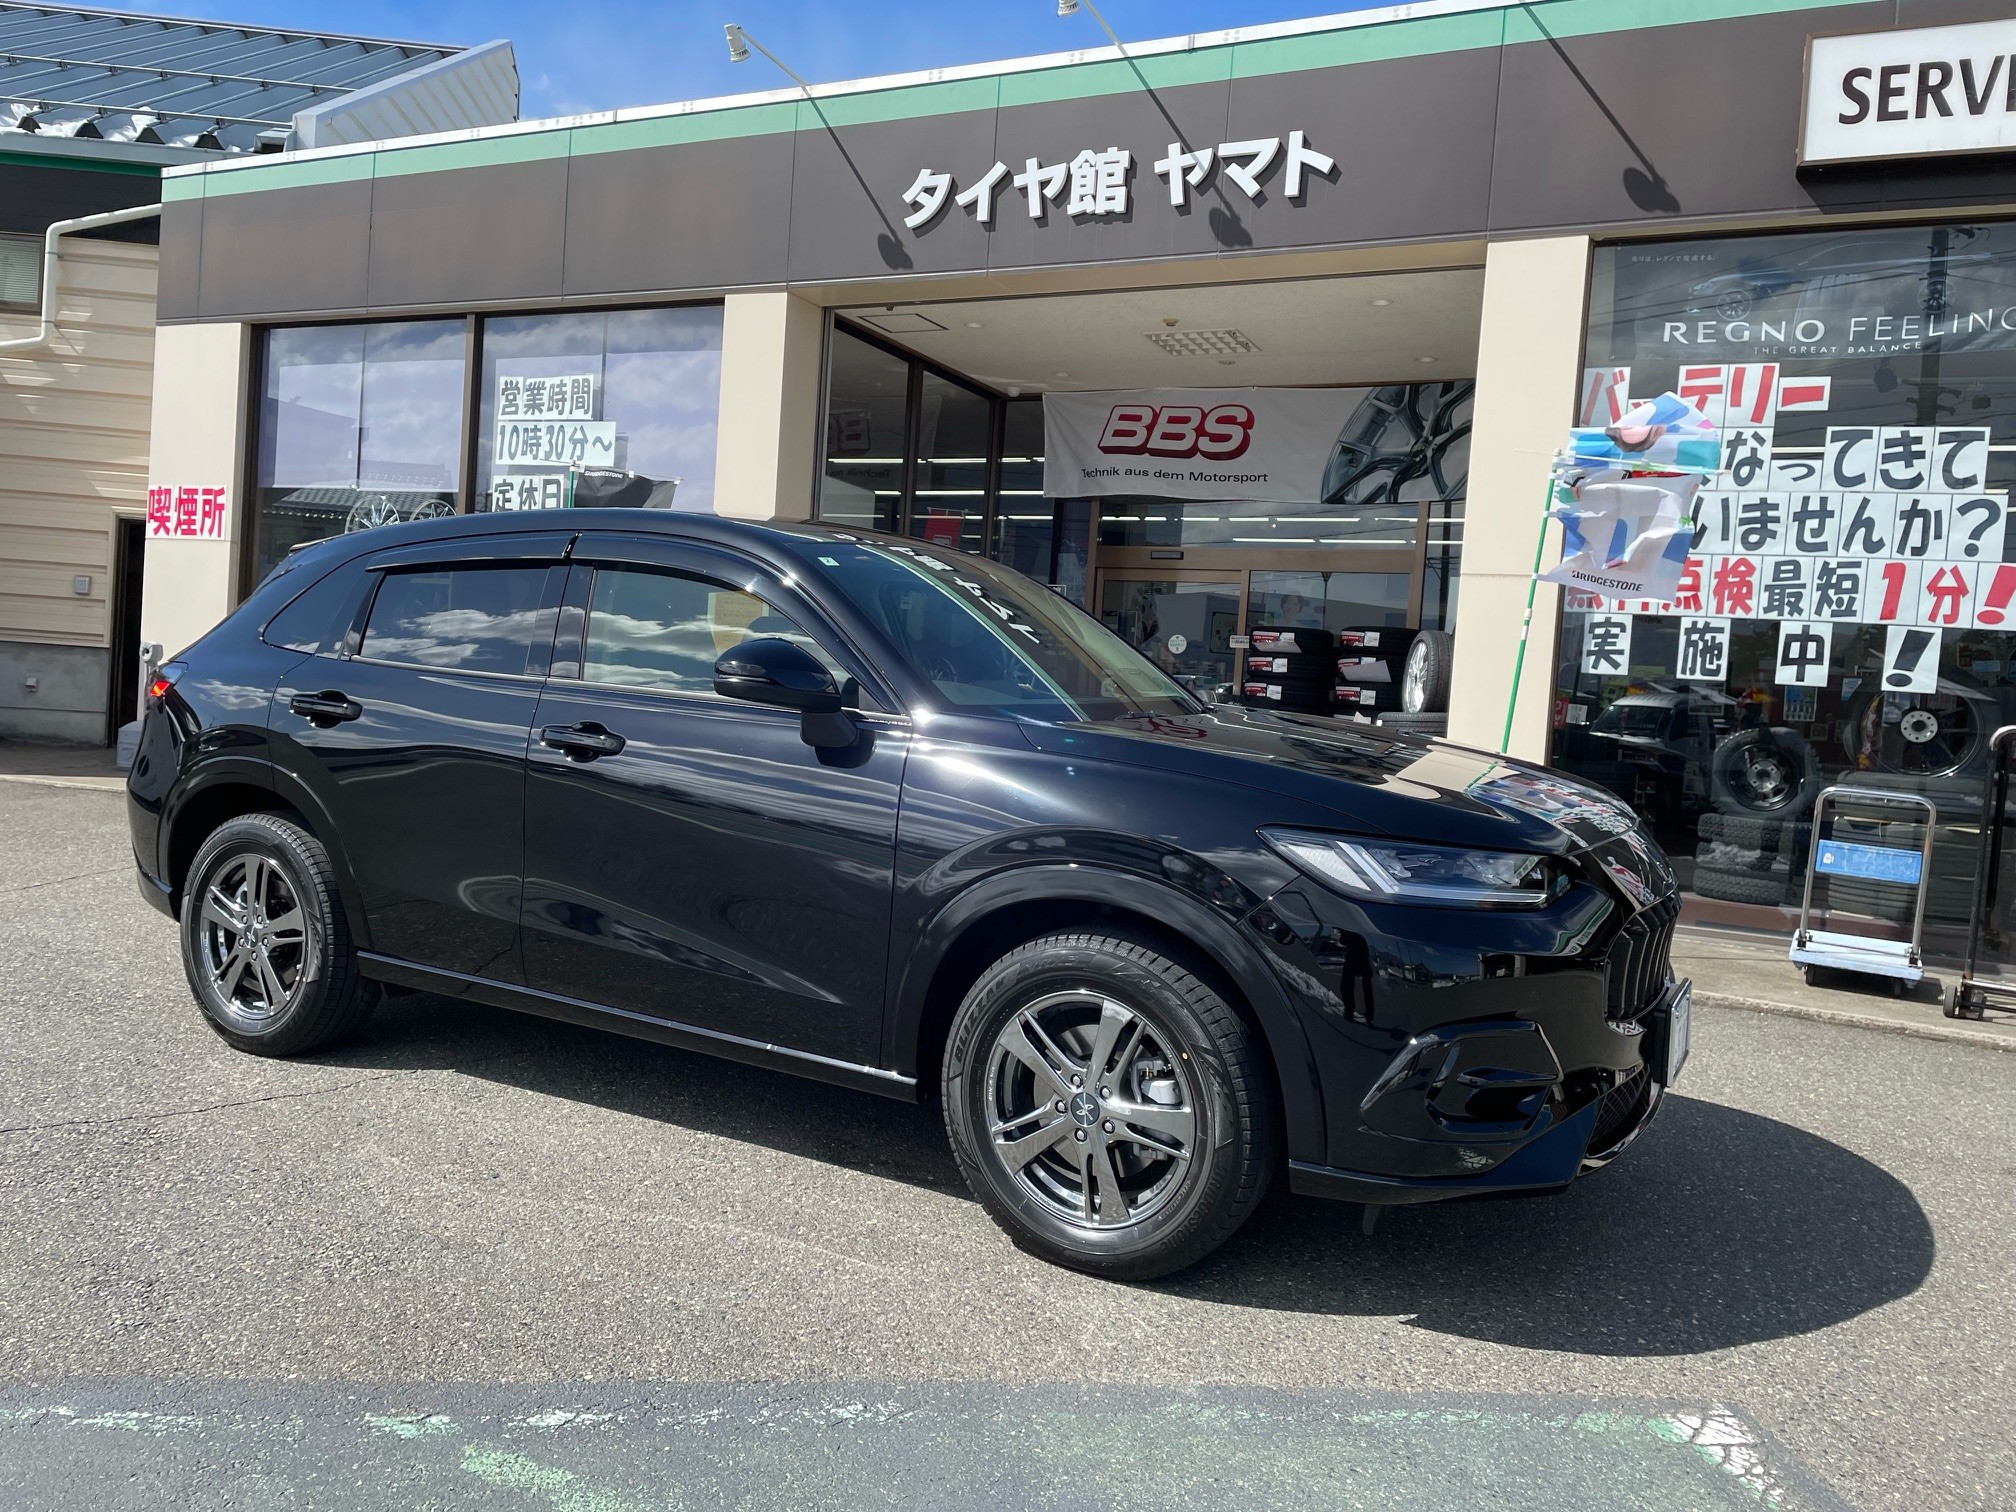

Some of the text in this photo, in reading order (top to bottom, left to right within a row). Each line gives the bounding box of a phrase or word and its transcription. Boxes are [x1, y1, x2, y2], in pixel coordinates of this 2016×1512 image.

[902, 130, 1334, 229] タイヤ館 ヤマト
[1663, 320, 1825, 344] REGNO
[1754, 341, 1922, 355] THE GREAT BALANCE
[501, 377, 591, 416] 営業時間
[1581, 365, 1825, 426] バテリー
[1098, 404, 1255, 461] BBS
[1081, 467, 1269, 484] Technik aus dem Motorsport
[1701, 429, 1986, 490] なってきて
[148, 486, 226, 538] 喫煙所
[493, 478, 563, 511] 定休日
[1571, 569, 1644, 593] BRIDGESTONE
